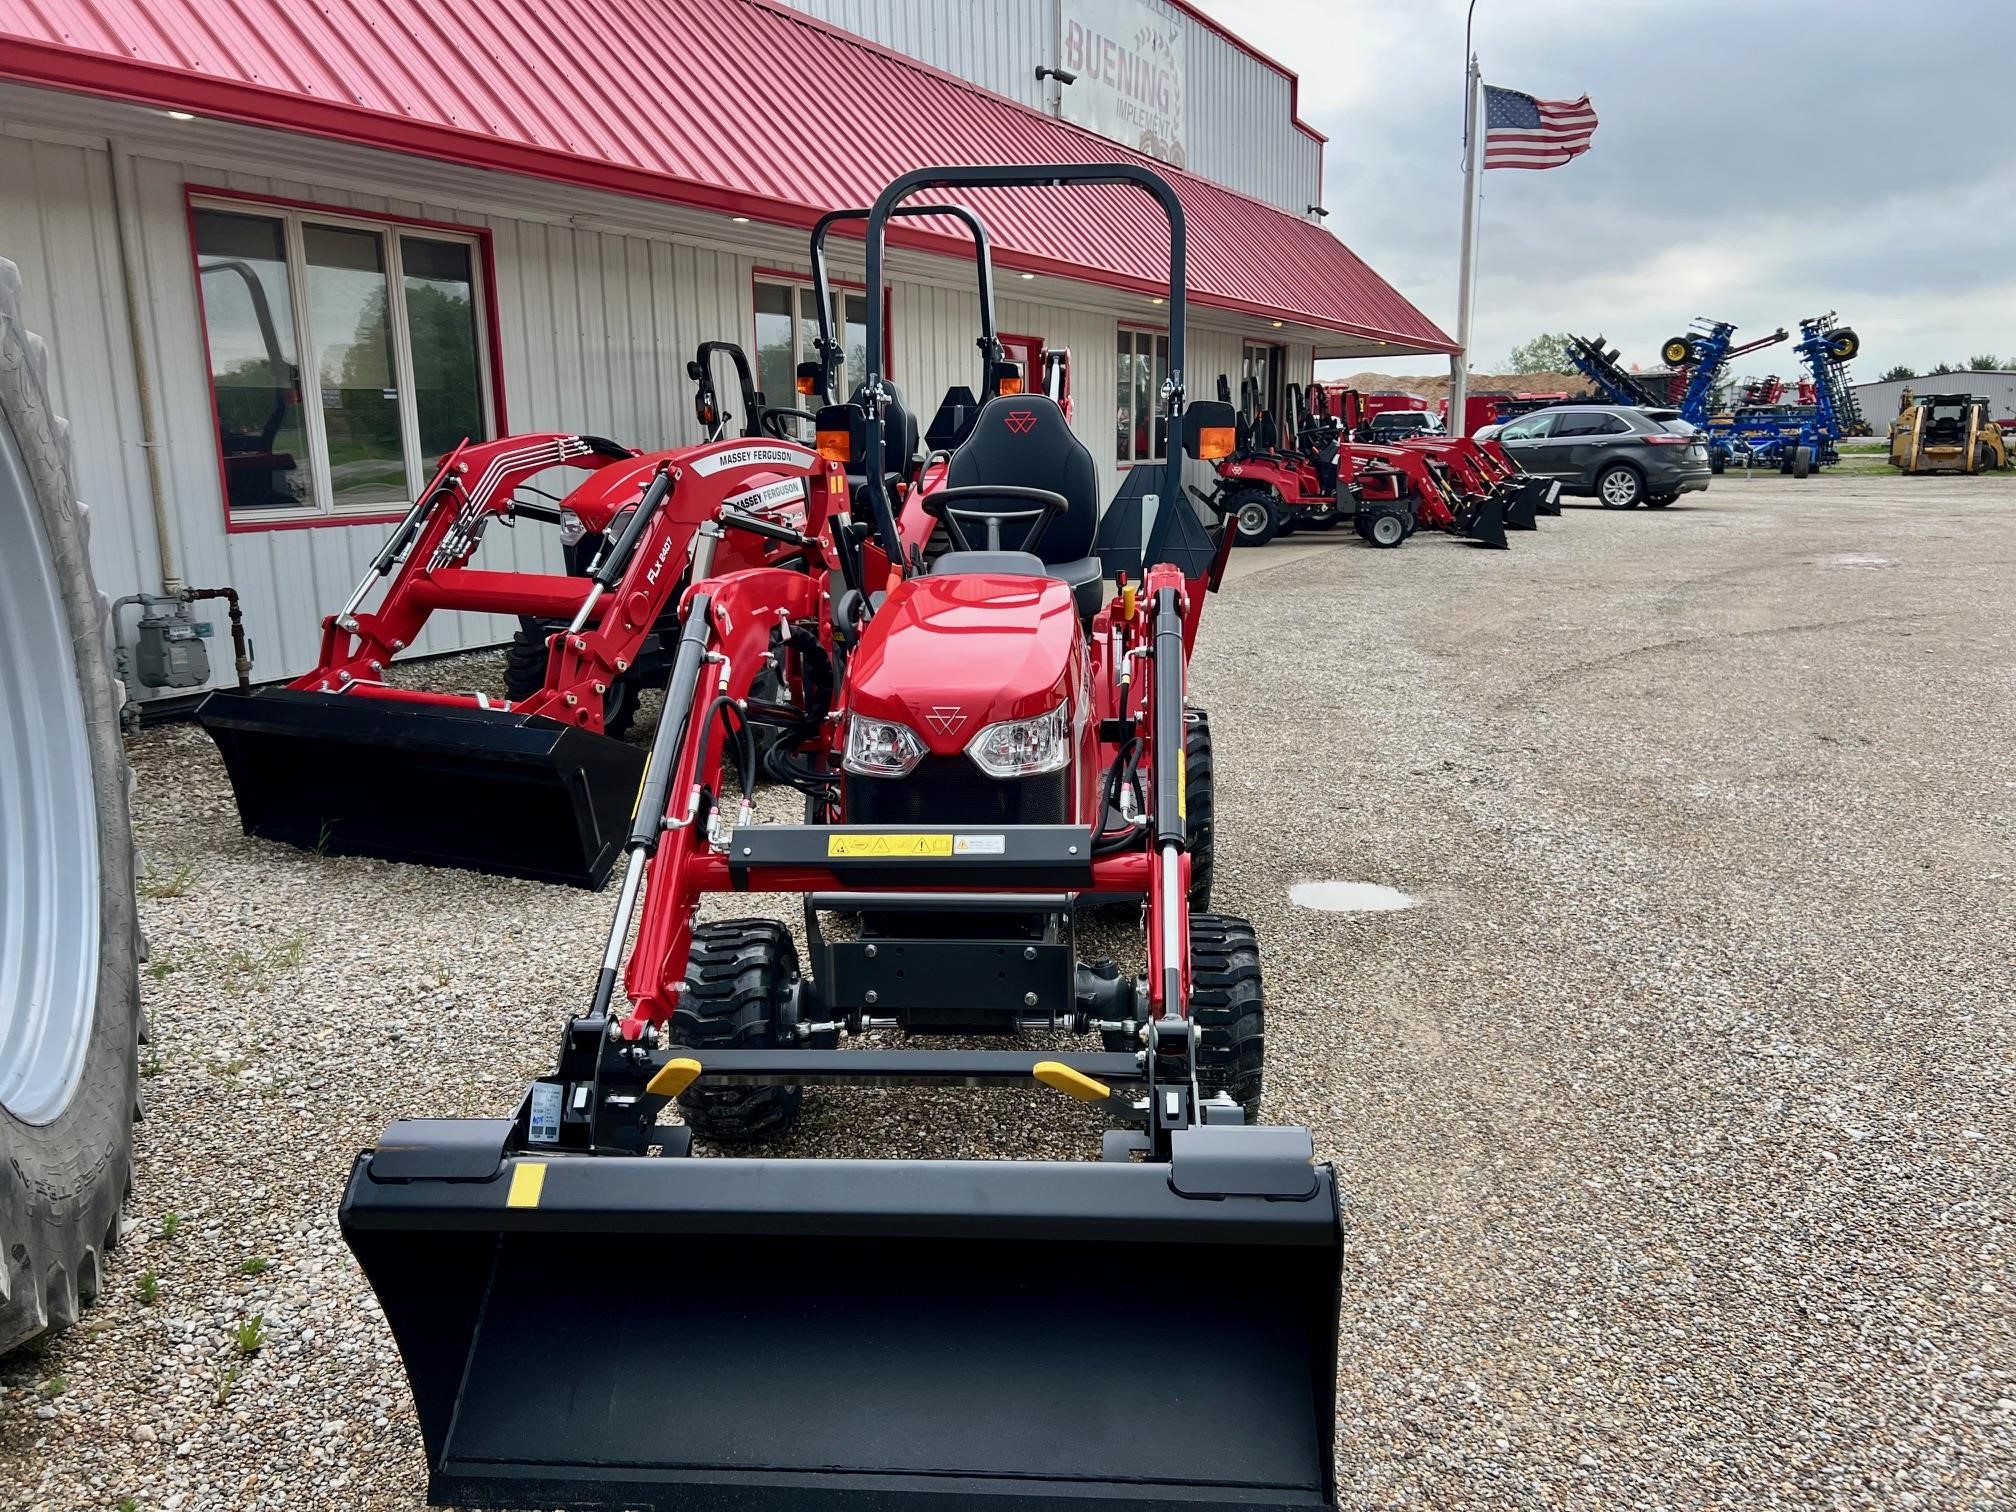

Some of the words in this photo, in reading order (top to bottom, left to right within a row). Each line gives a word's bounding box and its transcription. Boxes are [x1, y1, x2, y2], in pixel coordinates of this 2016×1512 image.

[1065, 19, 1170, 114] BUENING
[1115, 97, 1171, 139] IMPLEMENT
[719, 451, 752, 467] MASSEY
[753, 450, 792, 462] FERGUSON
[762, 482, 799, 501] FERGUSON
[646, 559, 663, 586] FLX
[658, 535, 673, 563] 2407
